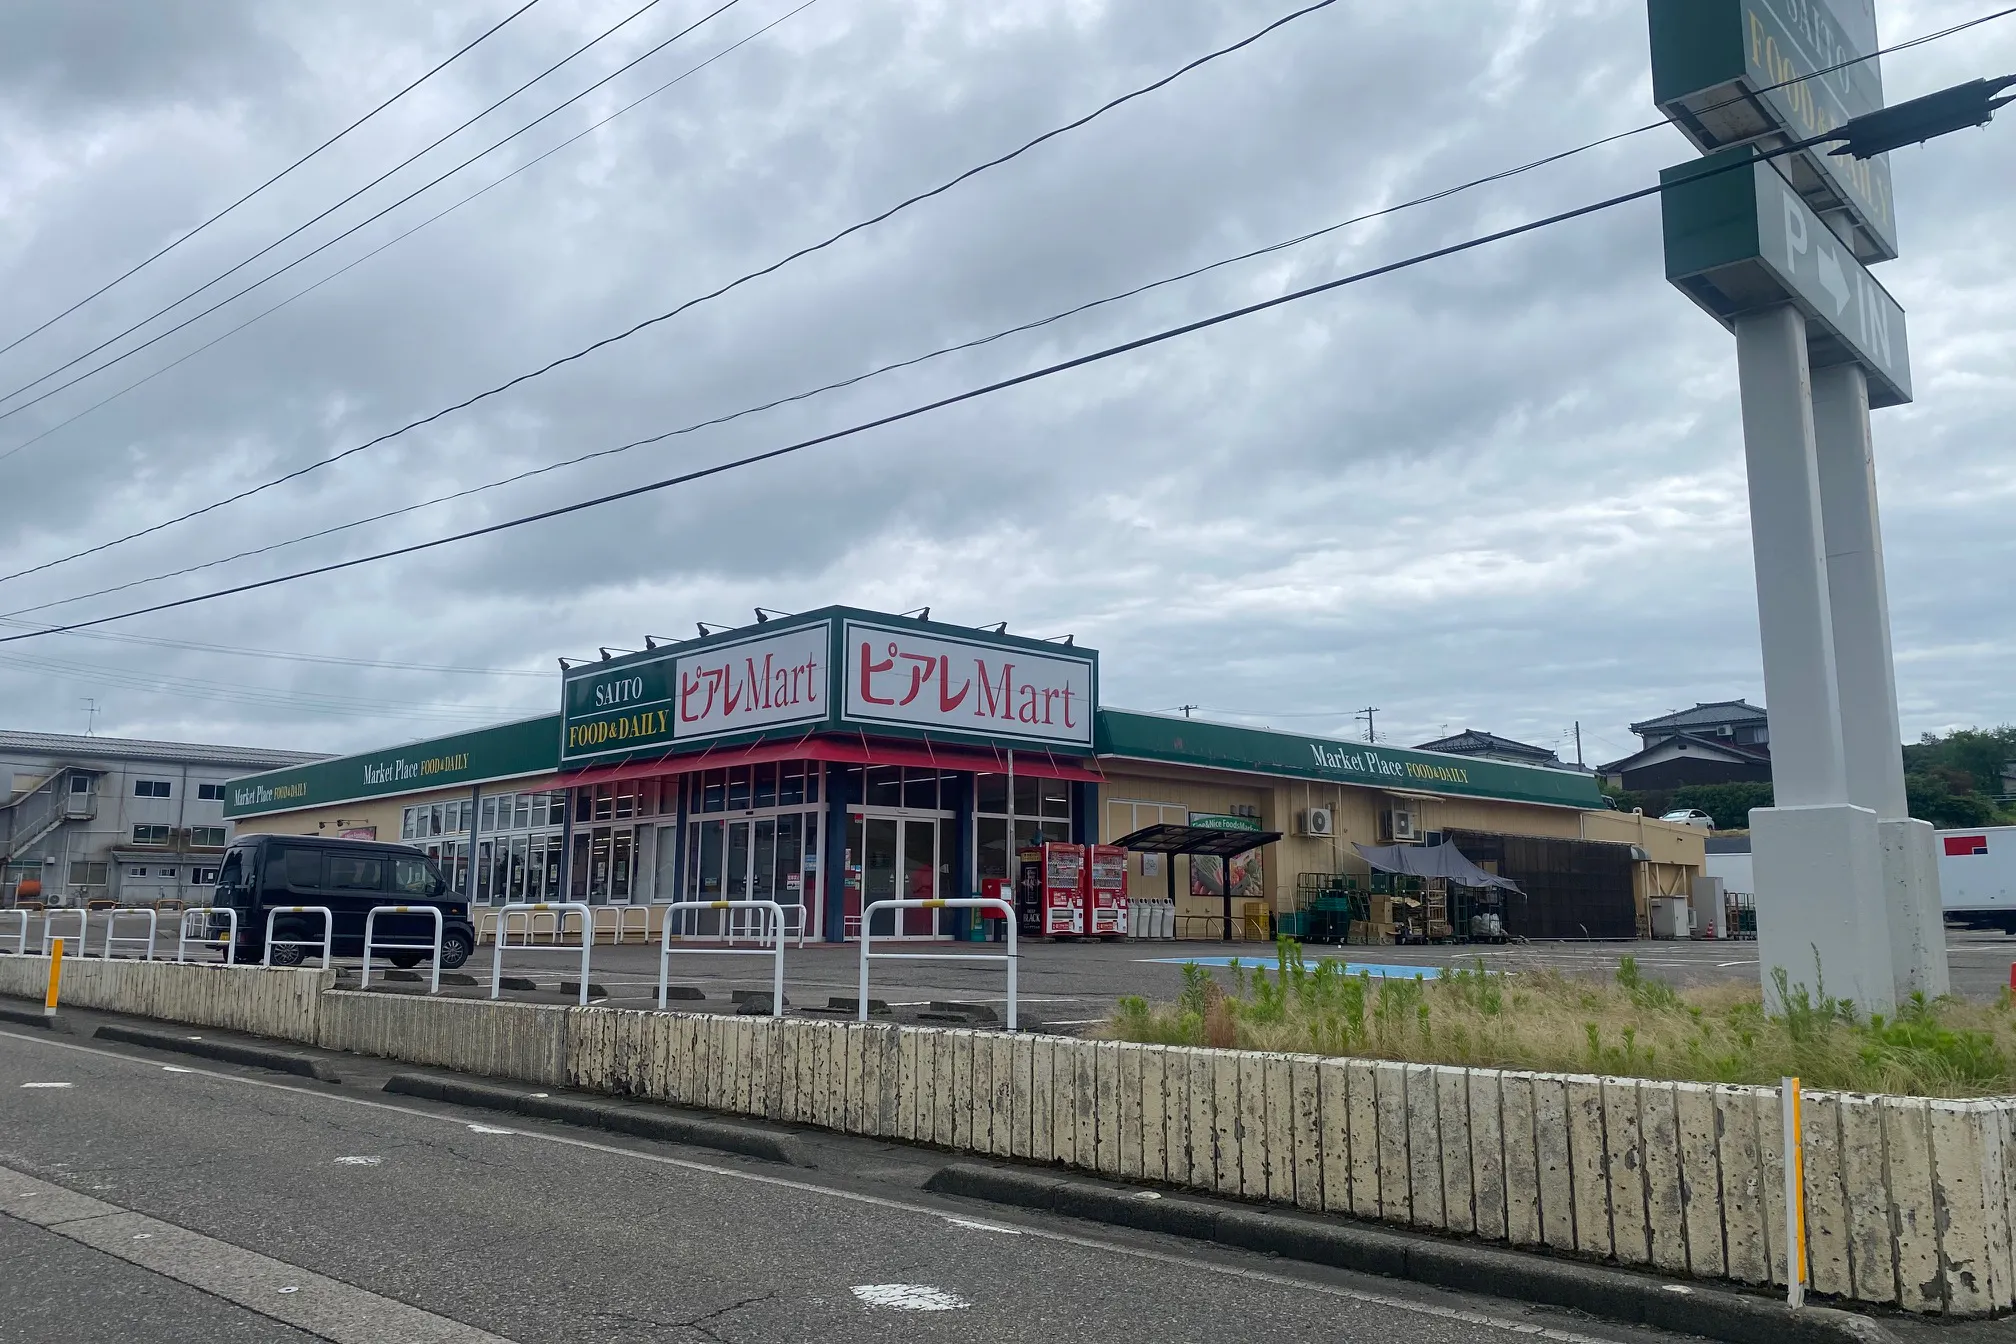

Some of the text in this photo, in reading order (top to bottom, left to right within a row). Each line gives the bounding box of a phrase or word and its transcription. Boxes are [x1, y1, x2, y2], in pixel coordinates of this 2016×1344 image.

[1783, 189, 1891, 368] P IN
[595, 676, 643, 707] SAITO
[363, 761, 392, 785] Market
[395, 759, 418, 781] Place
[1310, 744, 1365, 772] Market
[1364, 752, 1403, 777] Place
[234, 787, 255, 806] Market
[256, 785, 273, 804] Place
[1023, 913, 1041, 923] BLACK
